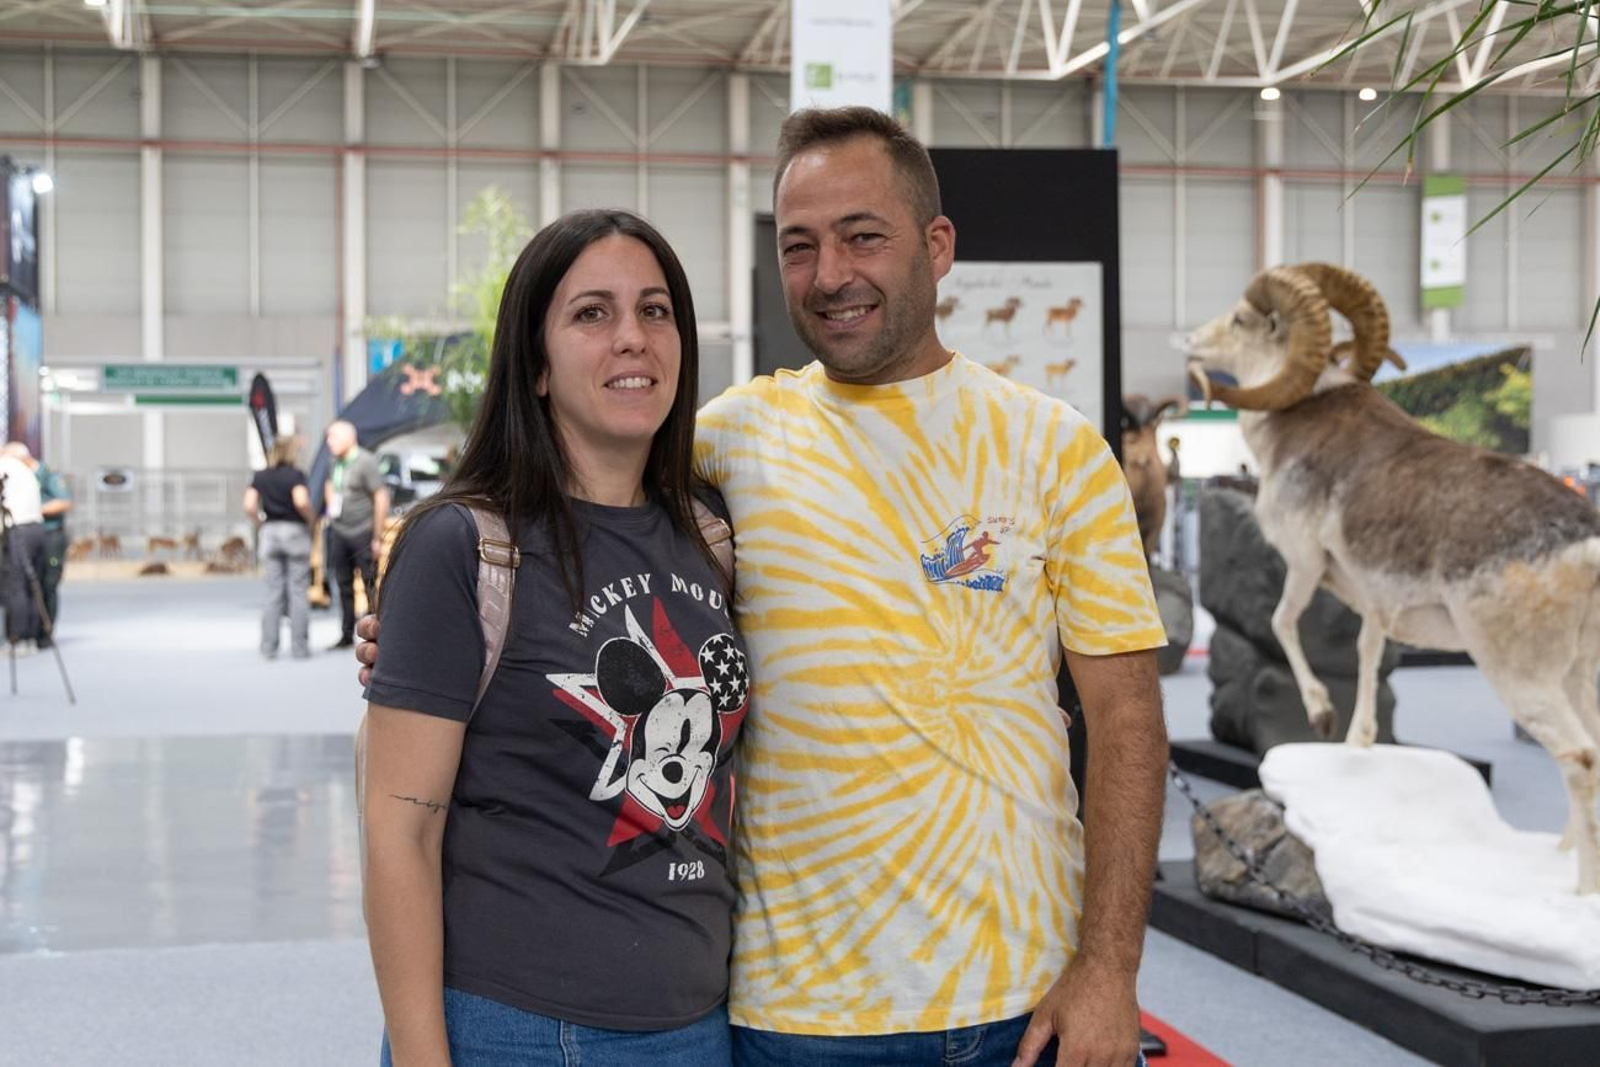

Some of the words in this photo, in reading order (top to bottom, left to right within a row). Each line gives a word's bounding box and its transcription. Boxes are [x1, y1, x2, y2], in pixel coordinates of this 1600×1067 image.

[568, 573, 651, 637] MICKEY
[671, 572, 730, 620] MOU
[668, 859, 705, 881] 1928
